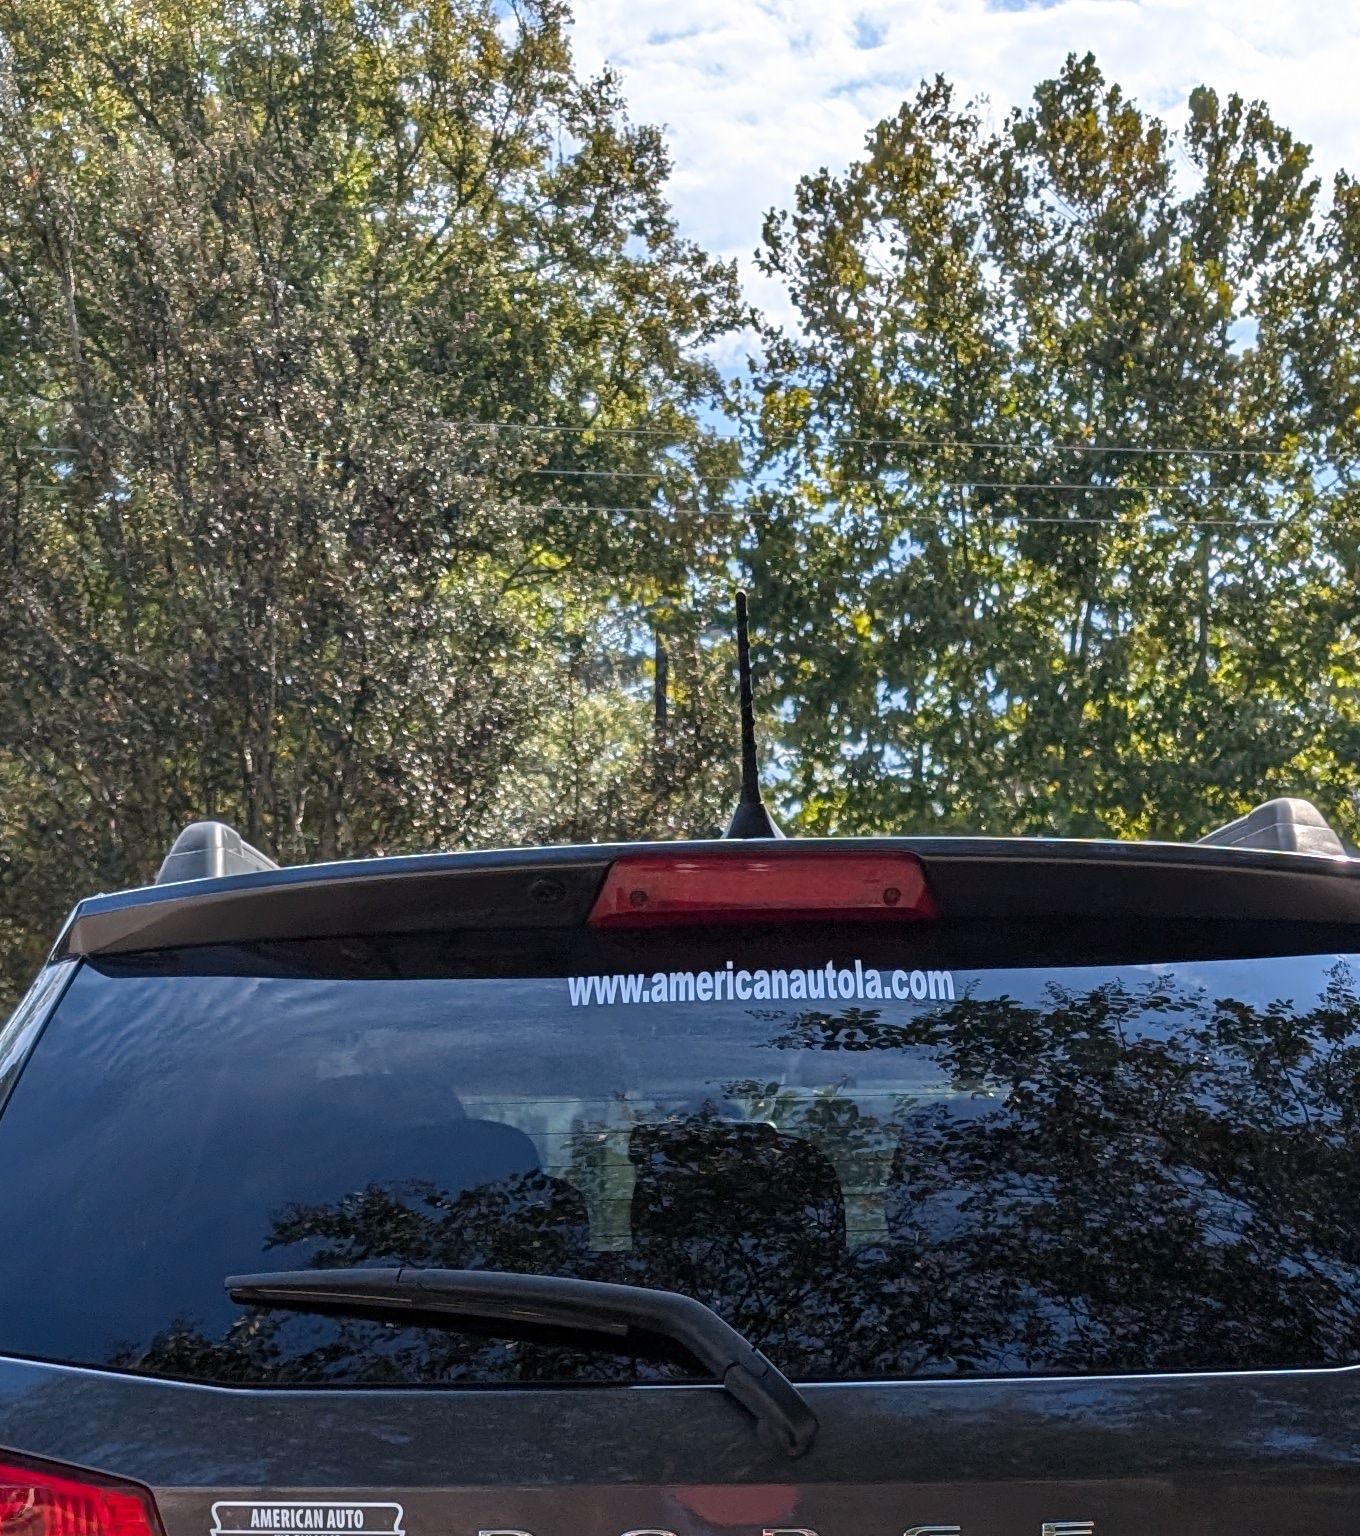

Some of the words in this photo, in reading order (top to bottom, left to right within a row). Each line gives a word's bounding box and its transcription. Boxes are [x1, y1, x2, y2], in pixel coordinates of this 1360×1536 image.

[568, 959, 956, 1006] www.americanautola.com
[251, 1508, 324, 1529] AMERICAN
[327, 1509, 364, 1529] AUTO
